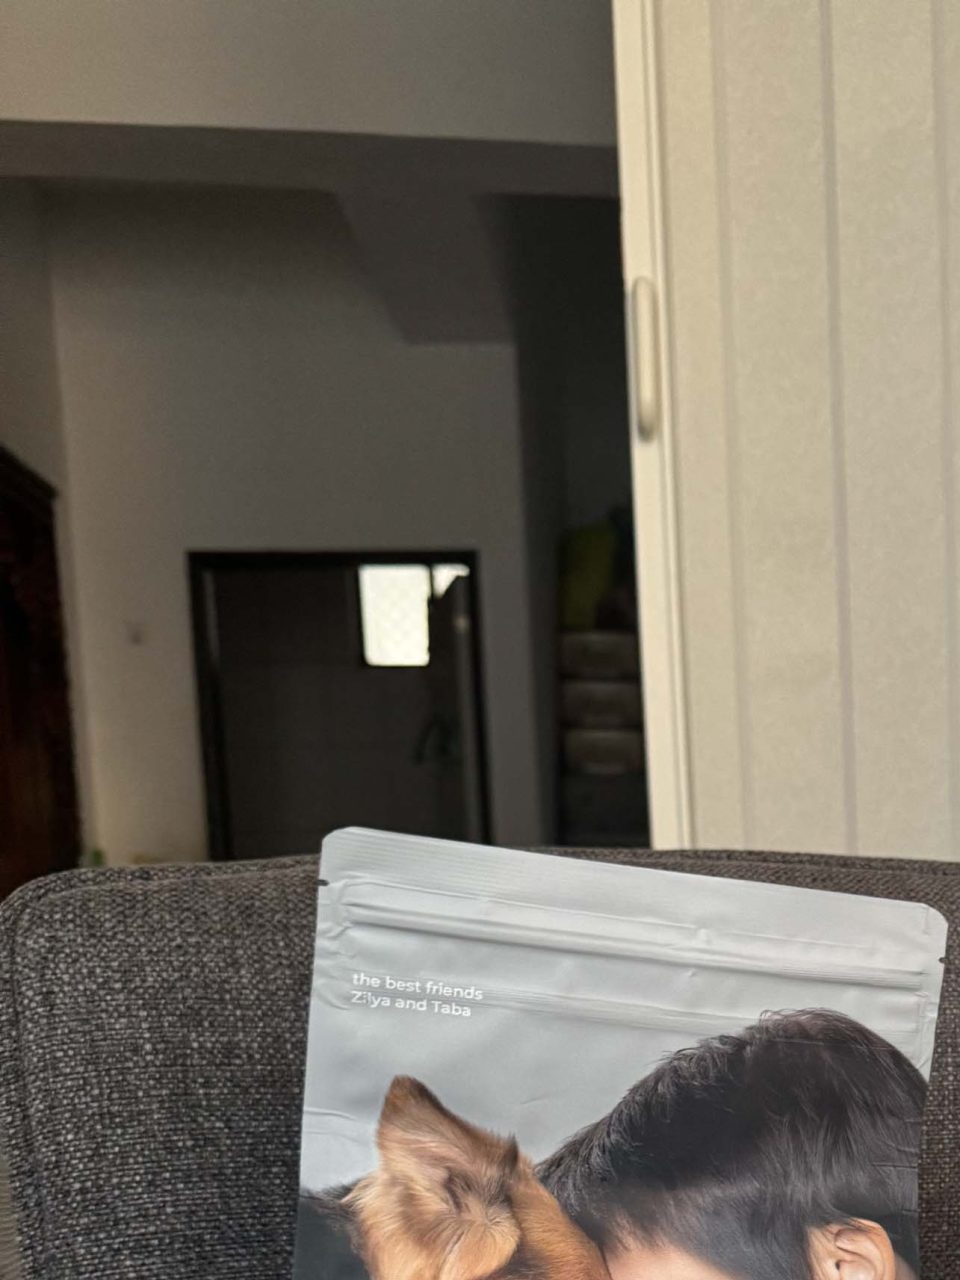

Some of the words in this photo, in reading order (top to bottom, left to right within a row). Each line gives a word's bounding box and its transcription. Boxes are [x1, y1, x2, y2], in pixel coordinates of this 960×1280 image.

[352, 972, 381, 987] the
[385, 976, 421, 992] best
[425, 981, 483, 1000] friends
[350, 990, 391, 1008] Zilya
[395, 998, 427, 1011] and
[432, 1001, 471, 1017] Taba
